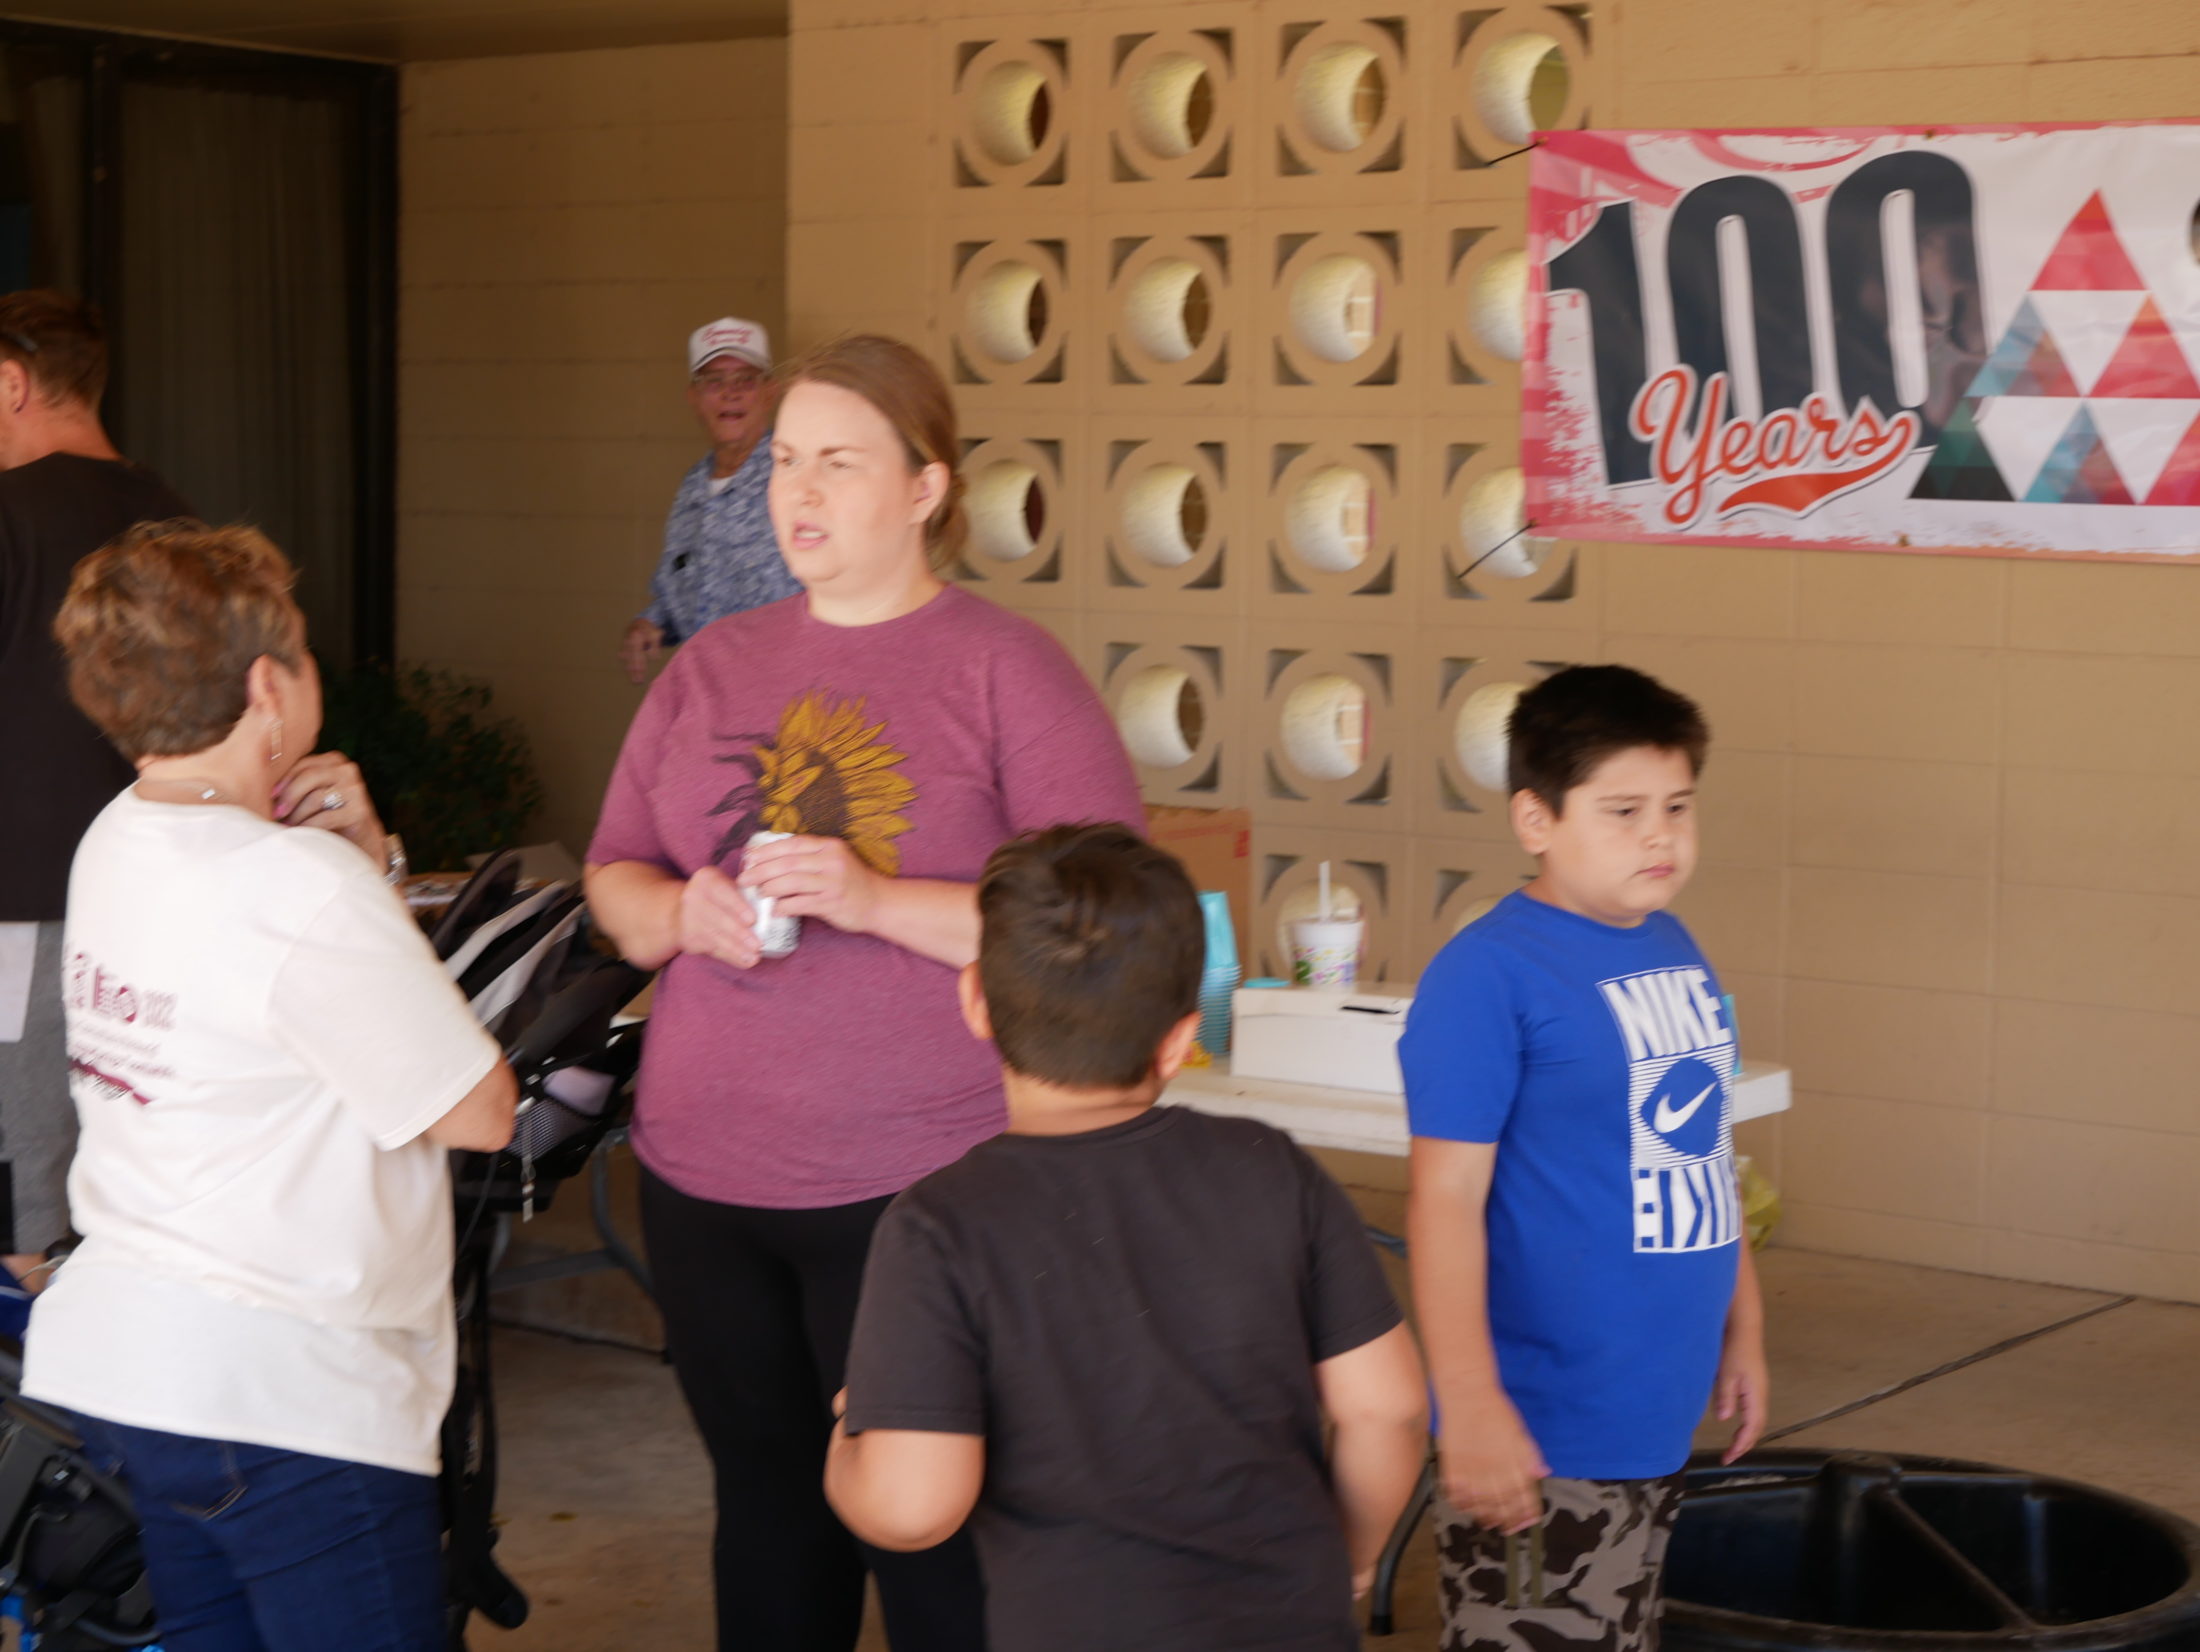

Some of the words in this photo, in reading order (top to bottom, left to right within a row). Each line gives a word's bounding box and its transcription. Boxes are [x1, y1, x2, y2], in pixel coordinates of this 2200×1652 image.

[1548, 150, 1988, 485] 100
[1637, 368, 1912, 525] Years
[1601, 968, 1733, 1062] NIKE
